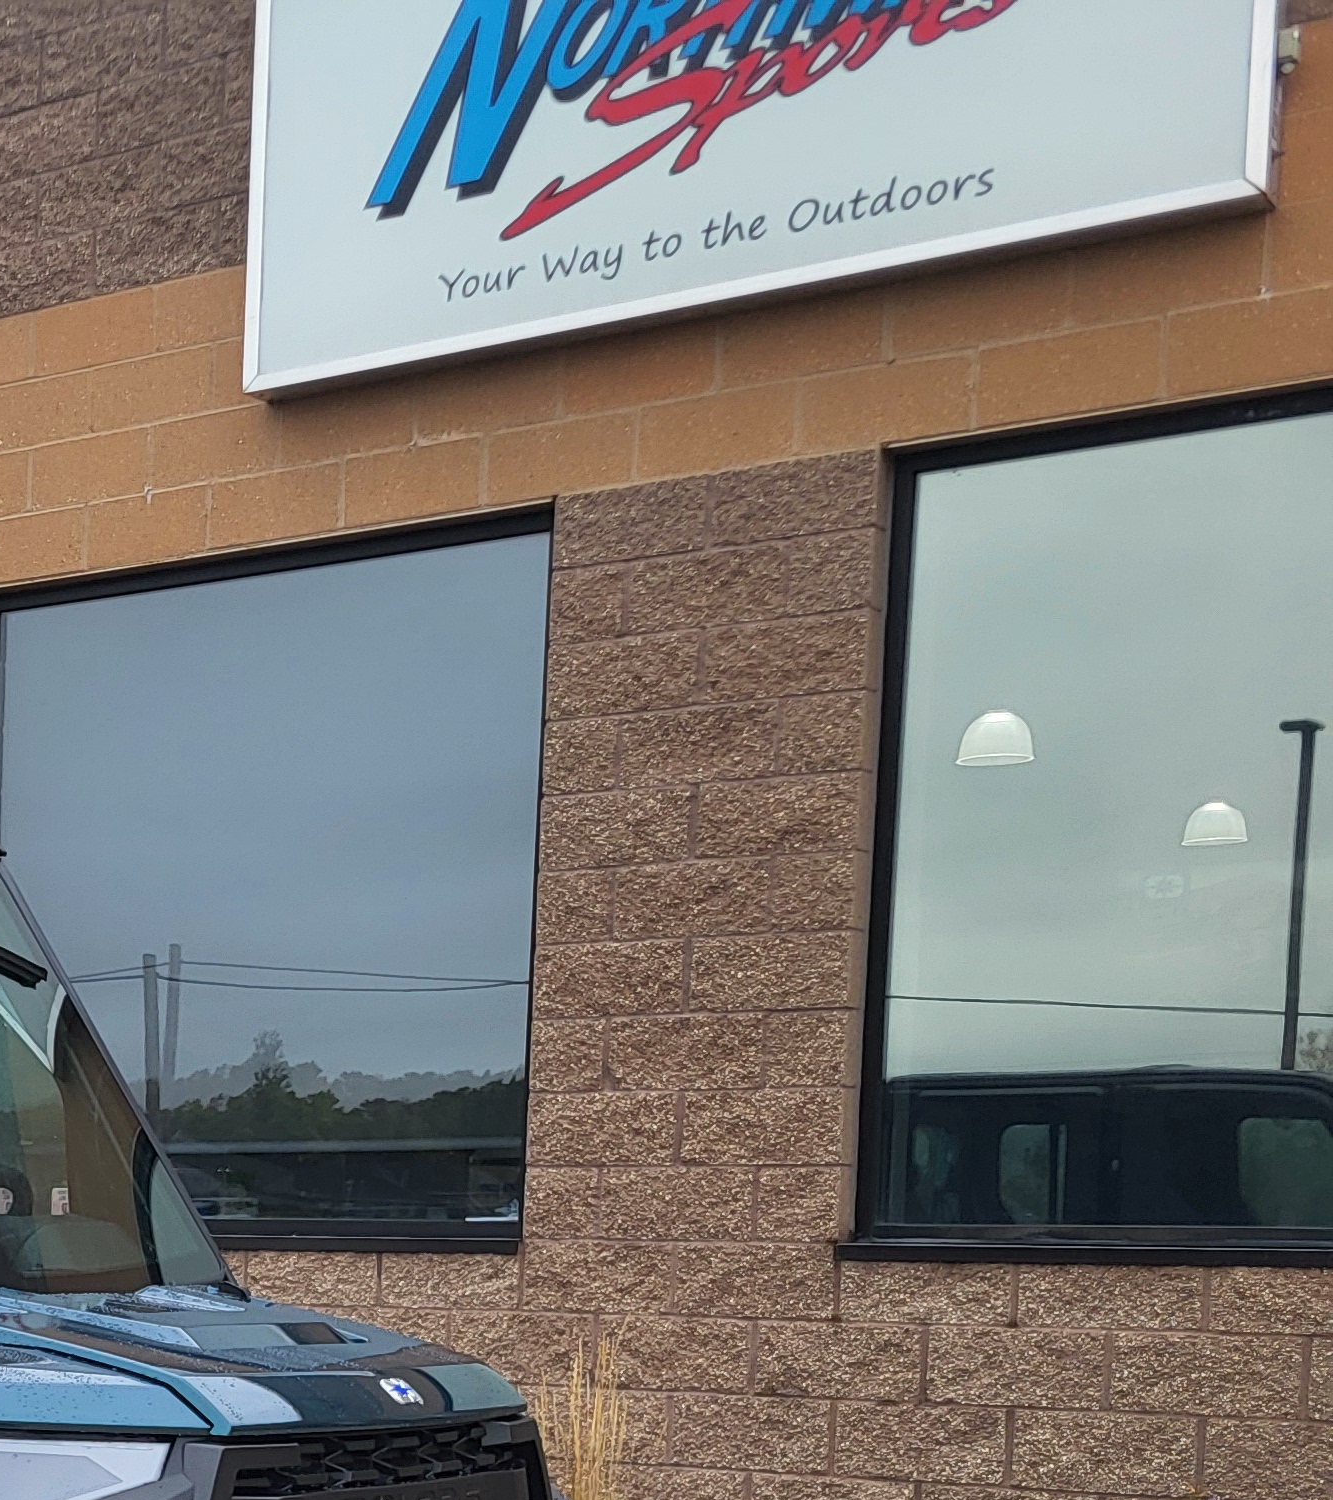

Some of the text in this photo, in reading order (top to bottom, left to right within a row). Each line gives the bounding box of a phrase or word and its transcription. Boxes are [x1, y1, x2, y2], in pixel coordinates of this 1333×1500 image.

[438, 168, 995, 302] Your Way to the Outdoors
